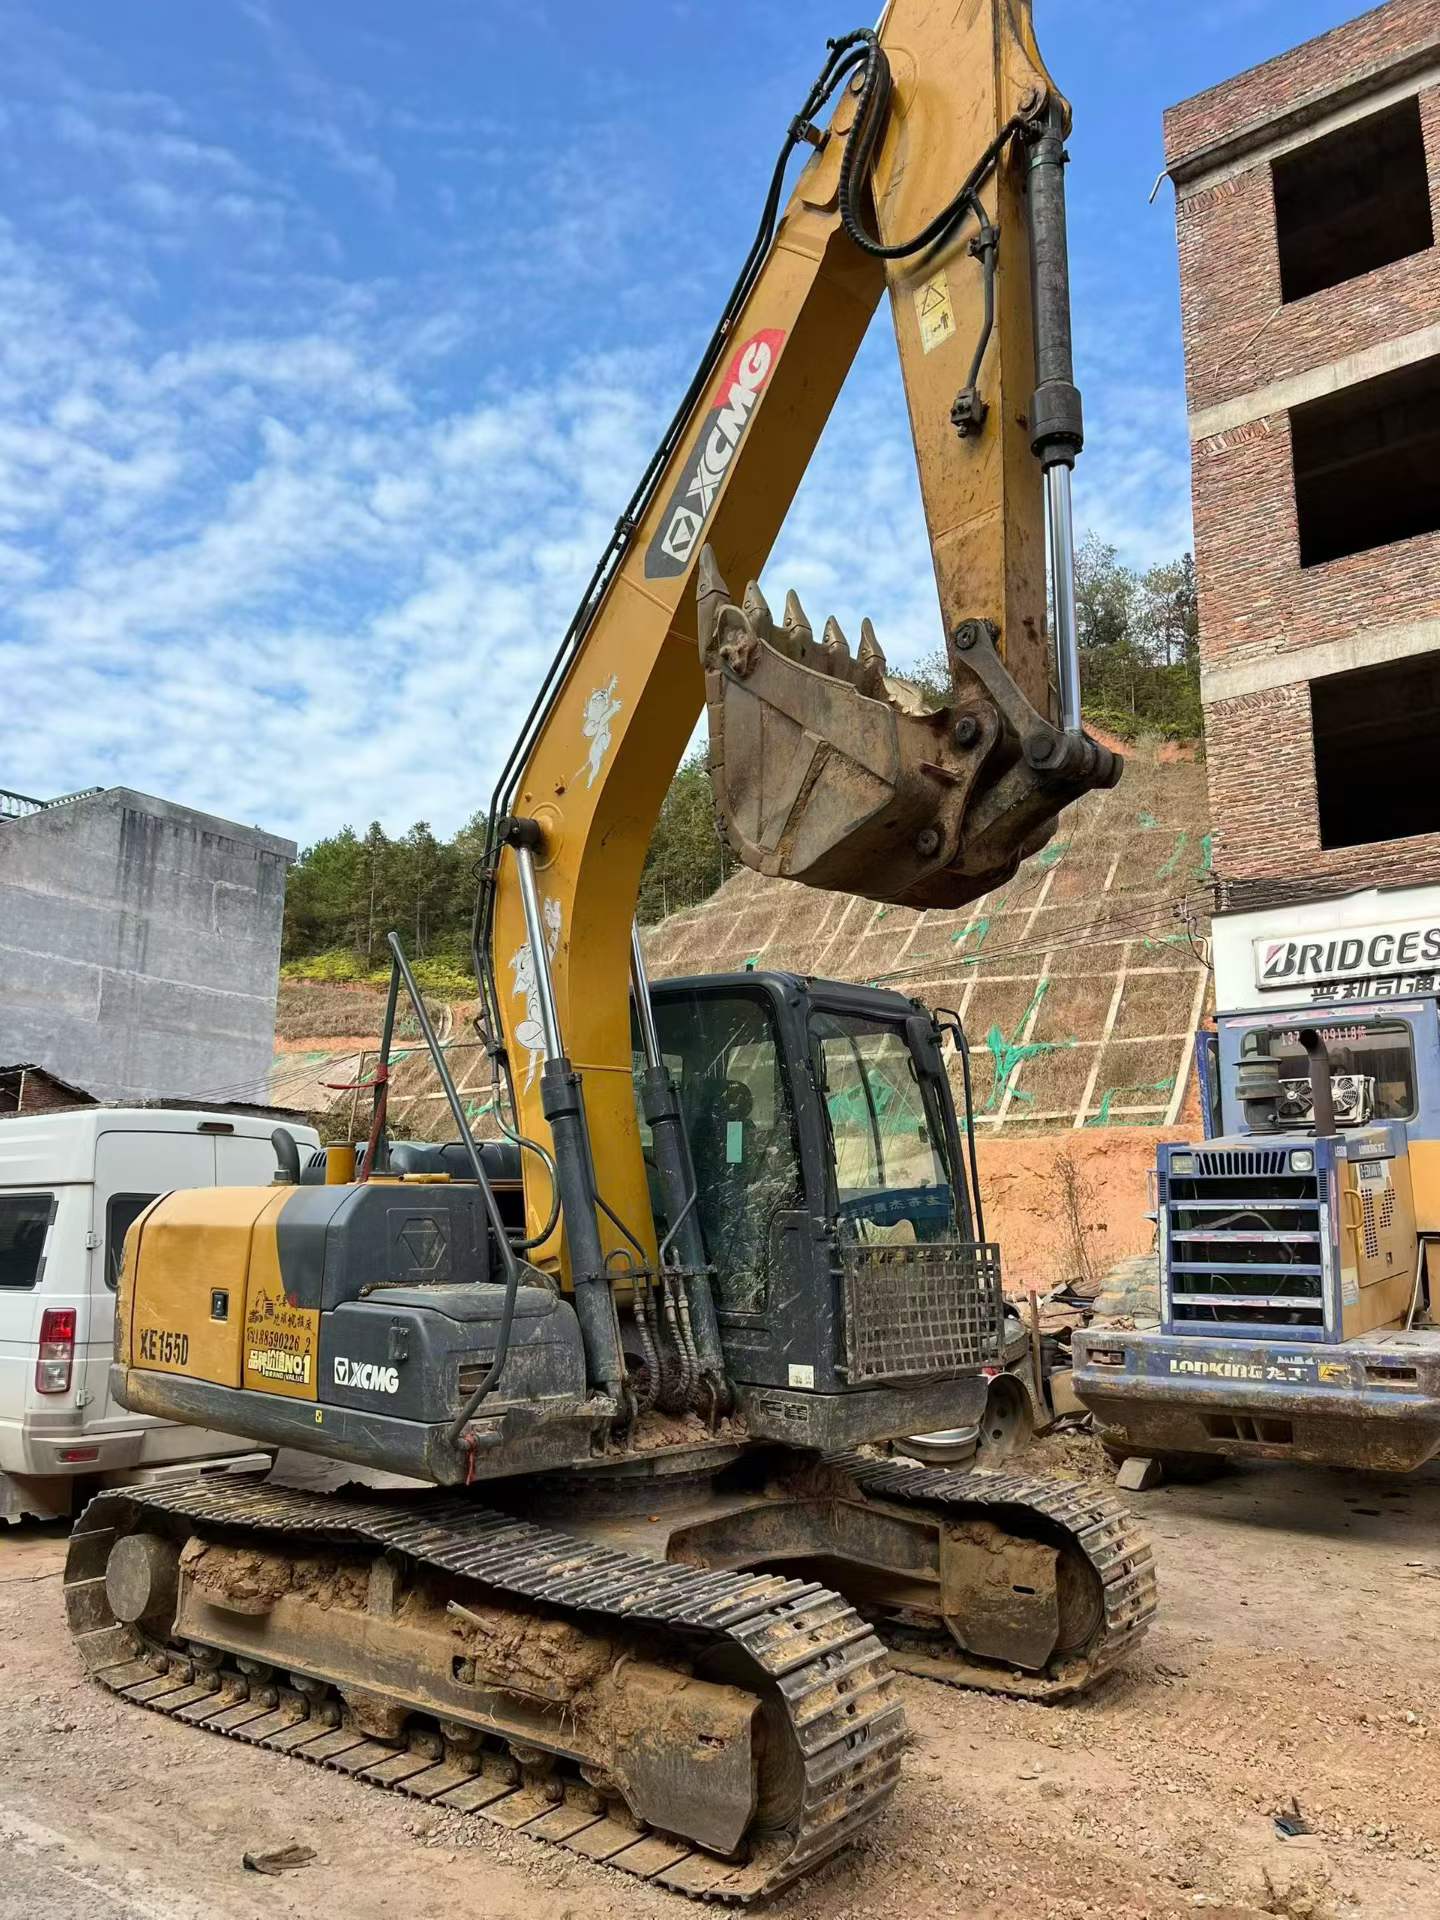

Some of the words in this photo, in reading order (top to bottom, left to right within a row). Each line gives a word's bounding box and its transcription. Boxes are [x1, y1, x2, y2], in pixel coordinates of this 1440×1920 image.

[686, 342, 771, 518] XCMG
[1263, 928, 1440, 978] BRIDGES
[140, 1328, 188, 1366] XE155D
[349, 1362, 399, 1394] XCMG
